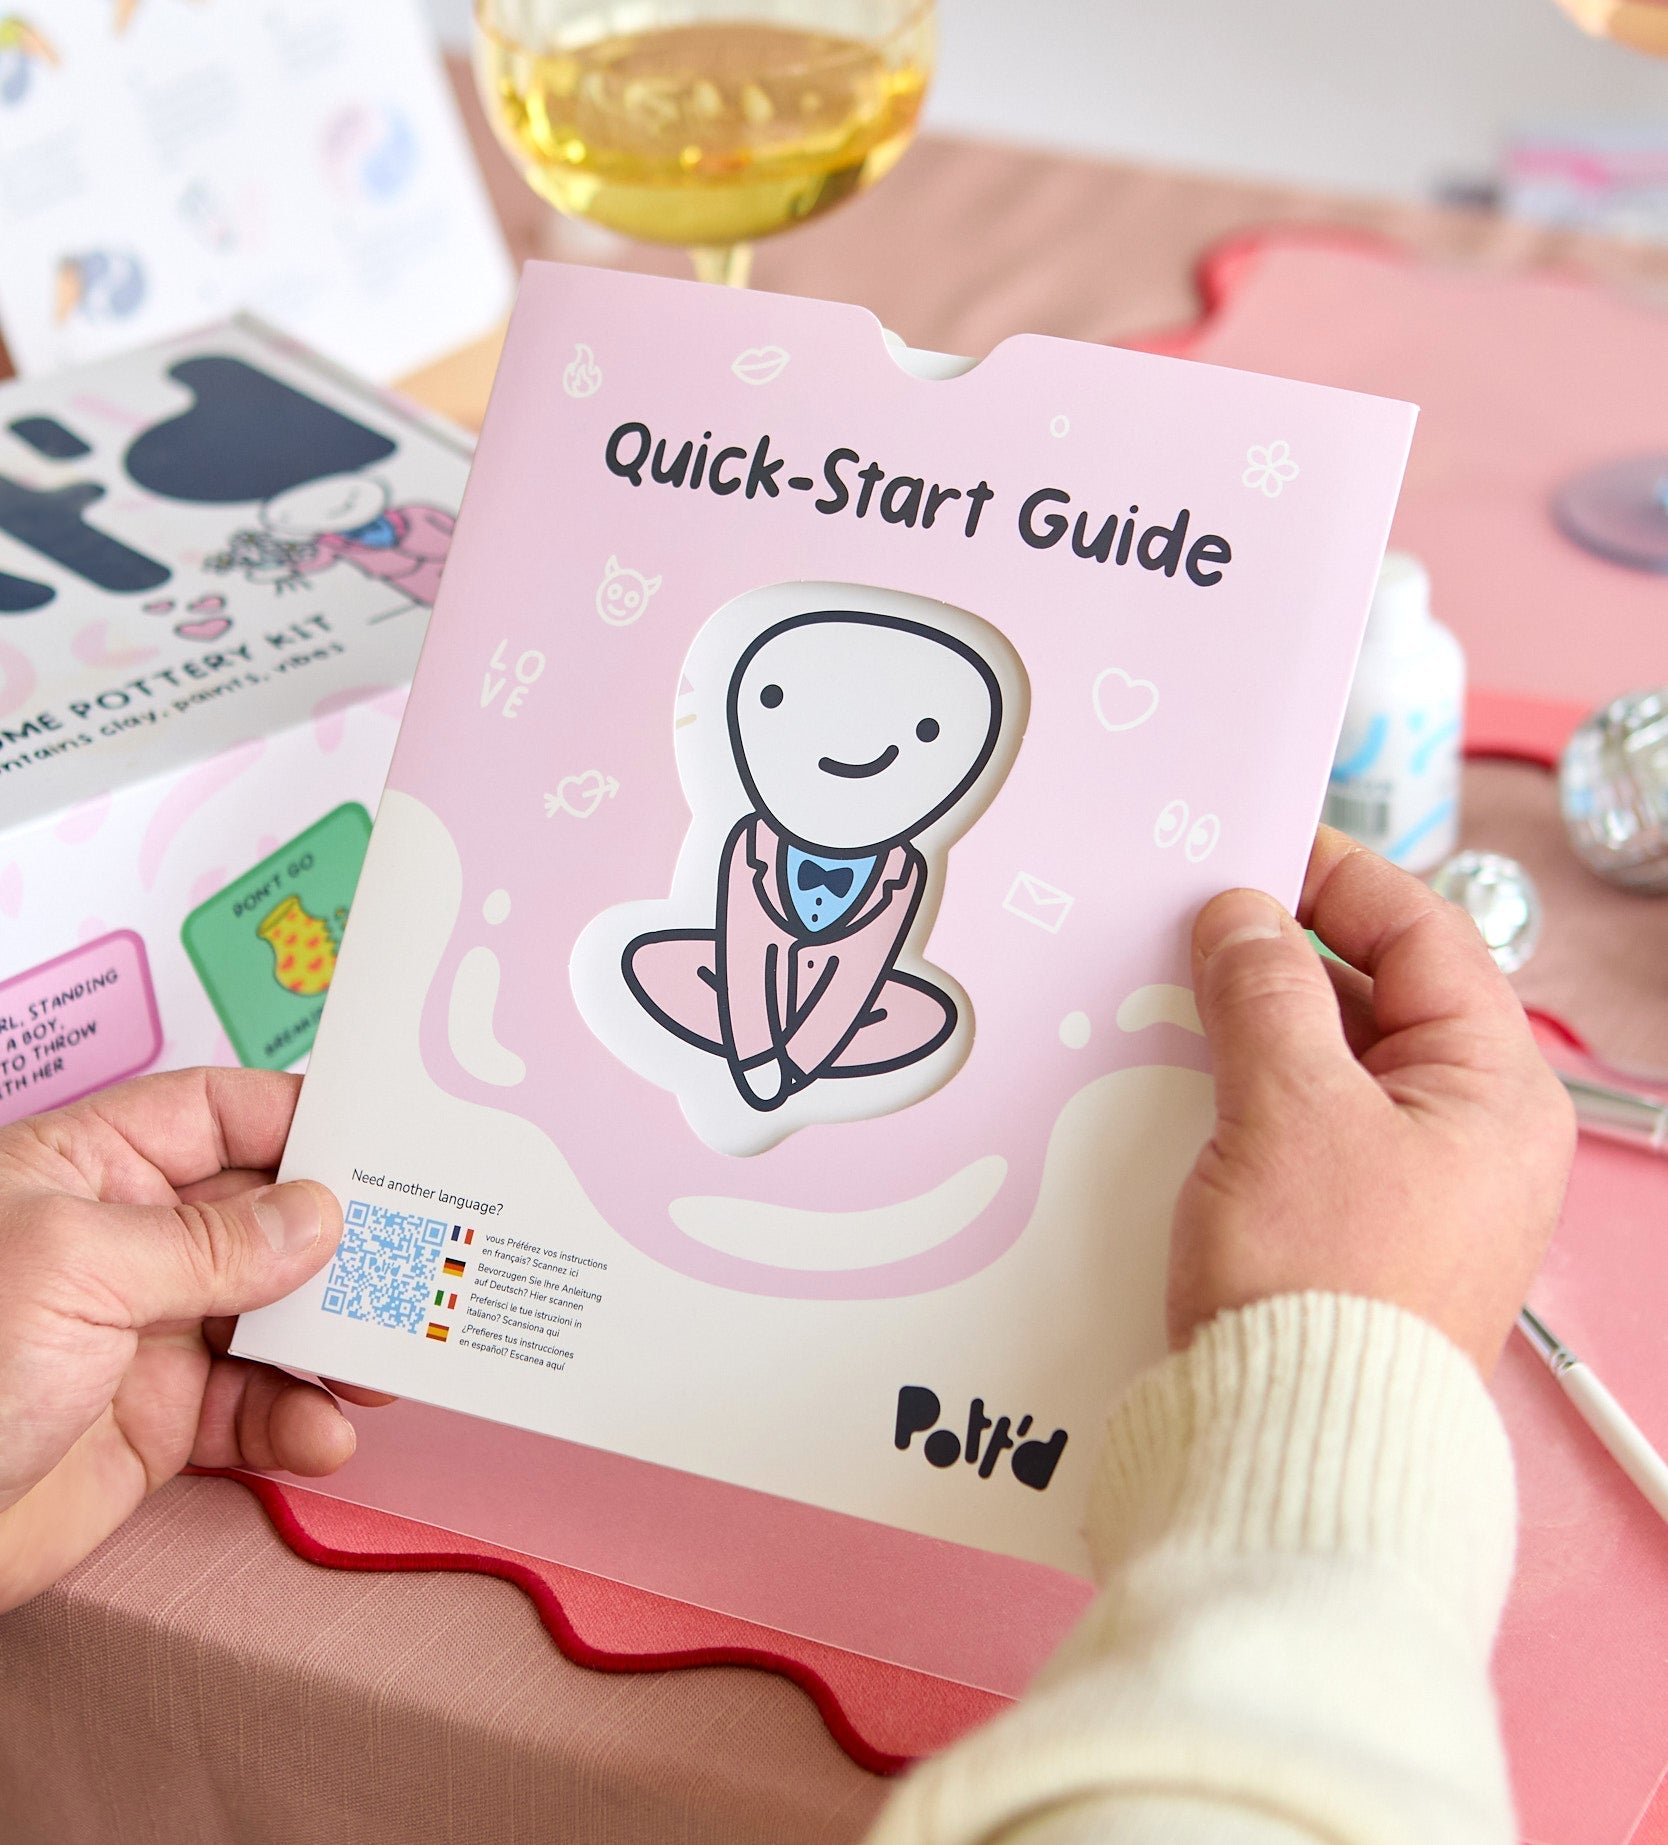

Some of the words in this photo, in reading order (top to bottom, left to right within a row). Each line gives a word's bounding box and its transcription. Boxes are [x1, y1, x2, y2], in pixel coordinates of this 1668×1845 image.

[603, 421, 994, 538] Quick-Start
[1017, 487, 1233, 588] Guide
[0, 711, 63, 749] ME
[69, 644, 252, 718] POTTERY
[265, 614, 332, 650] KIT
[0, 733, 93, 775] ntains
[273, 642, 345, 674] vibes
[233, 874, 282, 917] DON'T
[287, 853, 314, 879] GO
[28, 968, 118, 1021] STANDING
[2, 1054, 26, 1075] TO
[32, 1020, 97, 1060] THROW
[7, 1038, 17, 1053] A
[33, 1057, 64, 1083] HER
[351, 1169, 385, 1187] Need
[387, 1181, 436, 1199] another
[438, 1189, 503, 1215] language?
[481, 1248, 493, 1257] en
[494, 1249, 532, 1266] français?
[531, 1258, 568, 1276] Scannez
[568, 1267, 580, 1278] ici
[485, 1234, 506, 1246] vous
[506, 1237, 542, 1255] Préférez
[543, 1248, 558, 1259] vos
[558, 1250, 608, 1271] instructions
[473, 1278, 490, 1287] auf
[489, 1279, 529, 1298] Deutsch?
[529, 1289, 548, 1302] Hier
[548, 1296, 584, 1312] scannen
[477, 1262, 527, 1283] Bevorzugen
[528, 1275, 542, 1287] Sie
[543, 1279, 560, 1291] Ihre
[560, 1283, 603, 1304] Anleitung
[466, 1305, 502, 1323] italiano?
[501, 1315, 545, 1334] Scansiona
[545, 1328, 561, 1338] qui
[469, 1292, 509, 1310] Preferisci
[509, 1302, 518, 1313] le
[519, 1305, 534, 1317] tue
[534, 1308, 574, 1327] istruzioni
[573, 1318, 583, 1329] in
[458, 1338, 470, 1348] en
[471, 1341, 509, 1357] español?
[509, 1349, 545, 1367] Escanea
[545, 1360, 566, 1372] aquí
[461, 1323, 503, 1342] ¿Prefieres
[504, 1334, 518, 1345] tus
[519, 1337, 575, 1360] instrucciones
[894, 1385, 1068, 1491] Pott'd
